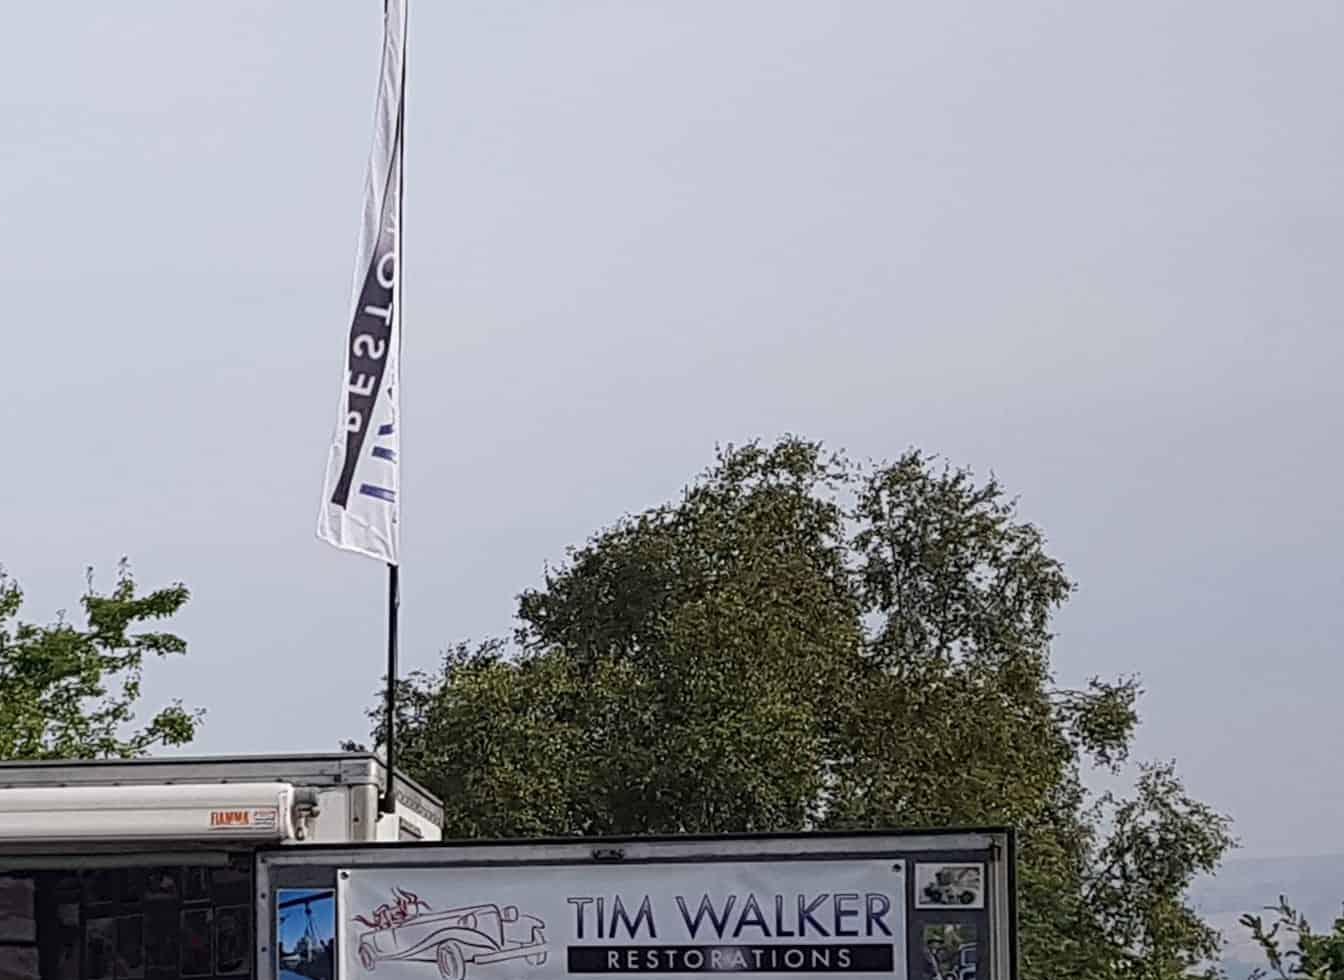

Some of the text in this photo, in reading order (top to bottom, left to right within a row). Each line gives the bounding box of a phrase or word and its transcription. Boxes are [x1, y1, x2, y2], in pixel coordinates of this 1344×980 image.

[567, 893, 894, 939] TIM WALKER
[607, 949, 852, 969] RESTORATIONS
